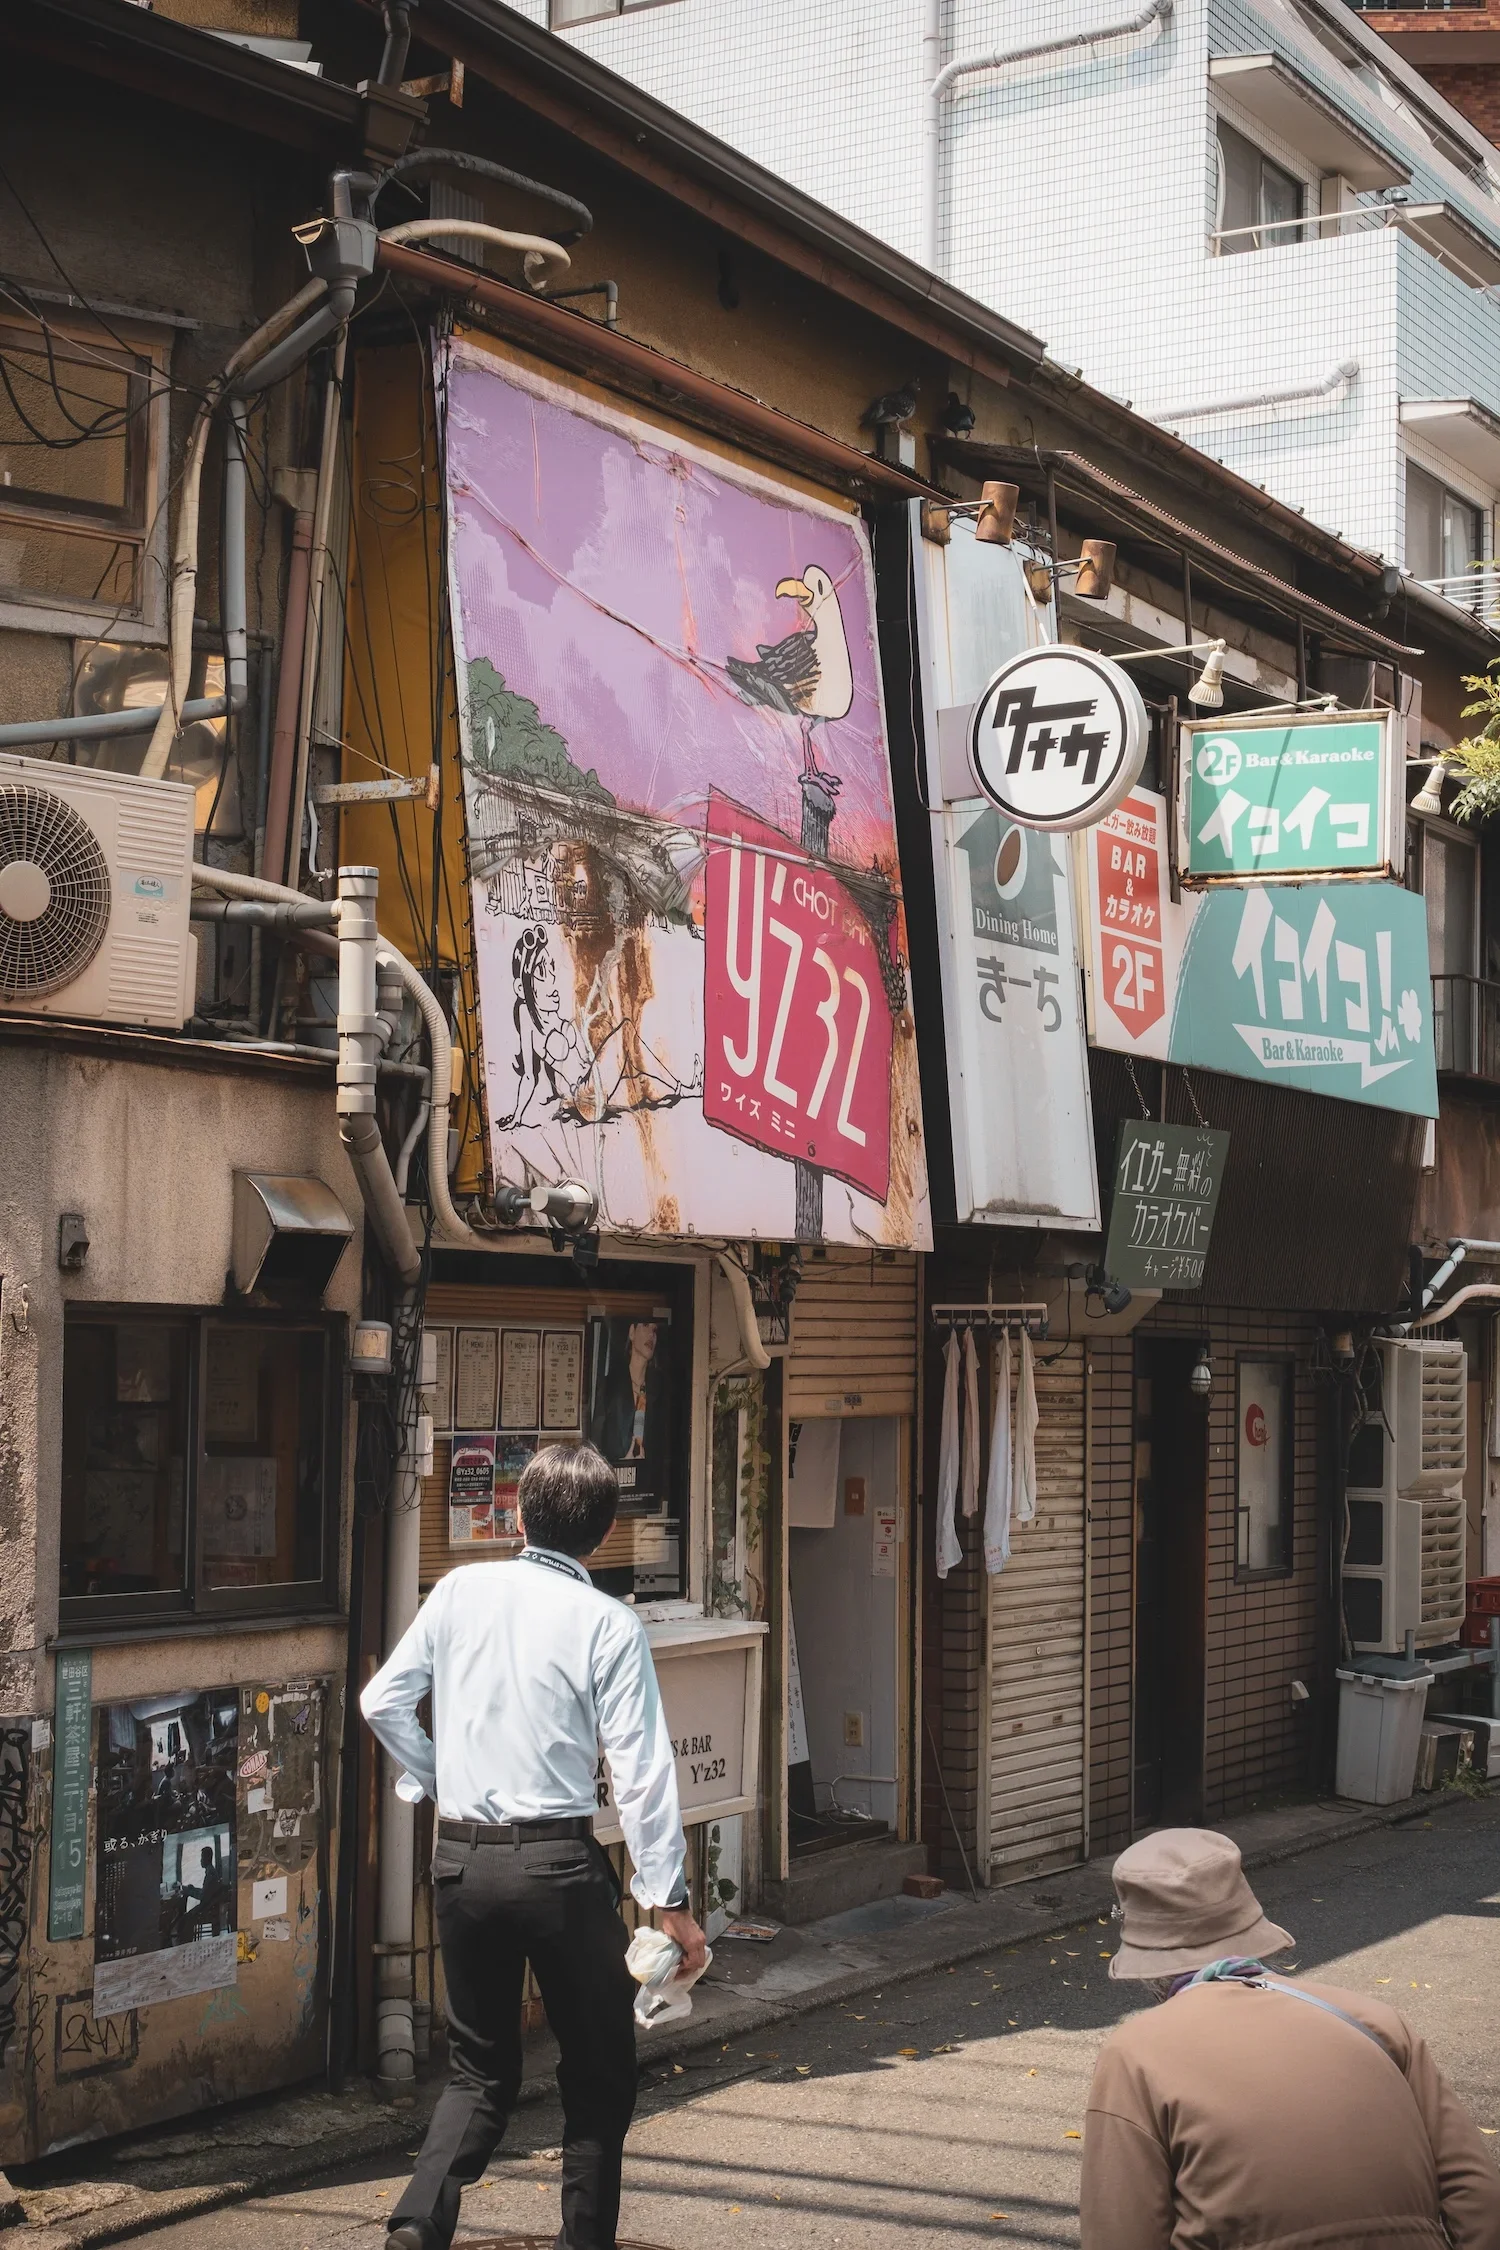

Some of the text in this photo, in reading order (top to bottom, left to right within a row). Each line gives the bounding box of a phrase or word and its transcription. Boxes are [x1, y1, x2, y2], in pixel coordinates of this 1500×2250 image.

[1204, 745, 1238, 777] 2F
[1197, 785, 1371, 859] イコイコ
[1110, 844, 1147, 880] BAR
[793, 877, 839, 927] CHOT
[1126, 877, 1134, 898] &
[975, 907, 1057, 946] Dining Home
[1105, 893, 1156, 929] カラオケ
[1112, 944, 1156, 1013] 2F
[720, 1081, 796, 1139] ワイズ ミニ
[1131, 1200, 1209, 1247] カラオケバー
[62, 1665, 88, 1680] 世田谷区
[63, 1681, 82, 1832] 三軒茶屋二丁目
[681, 1738, 690, 1757] &
[691, 1734, 712, 1755] BAR
[690, 1757, 726, 1784] Y'z32
[53, 1910, 73, 1926] 2-15
